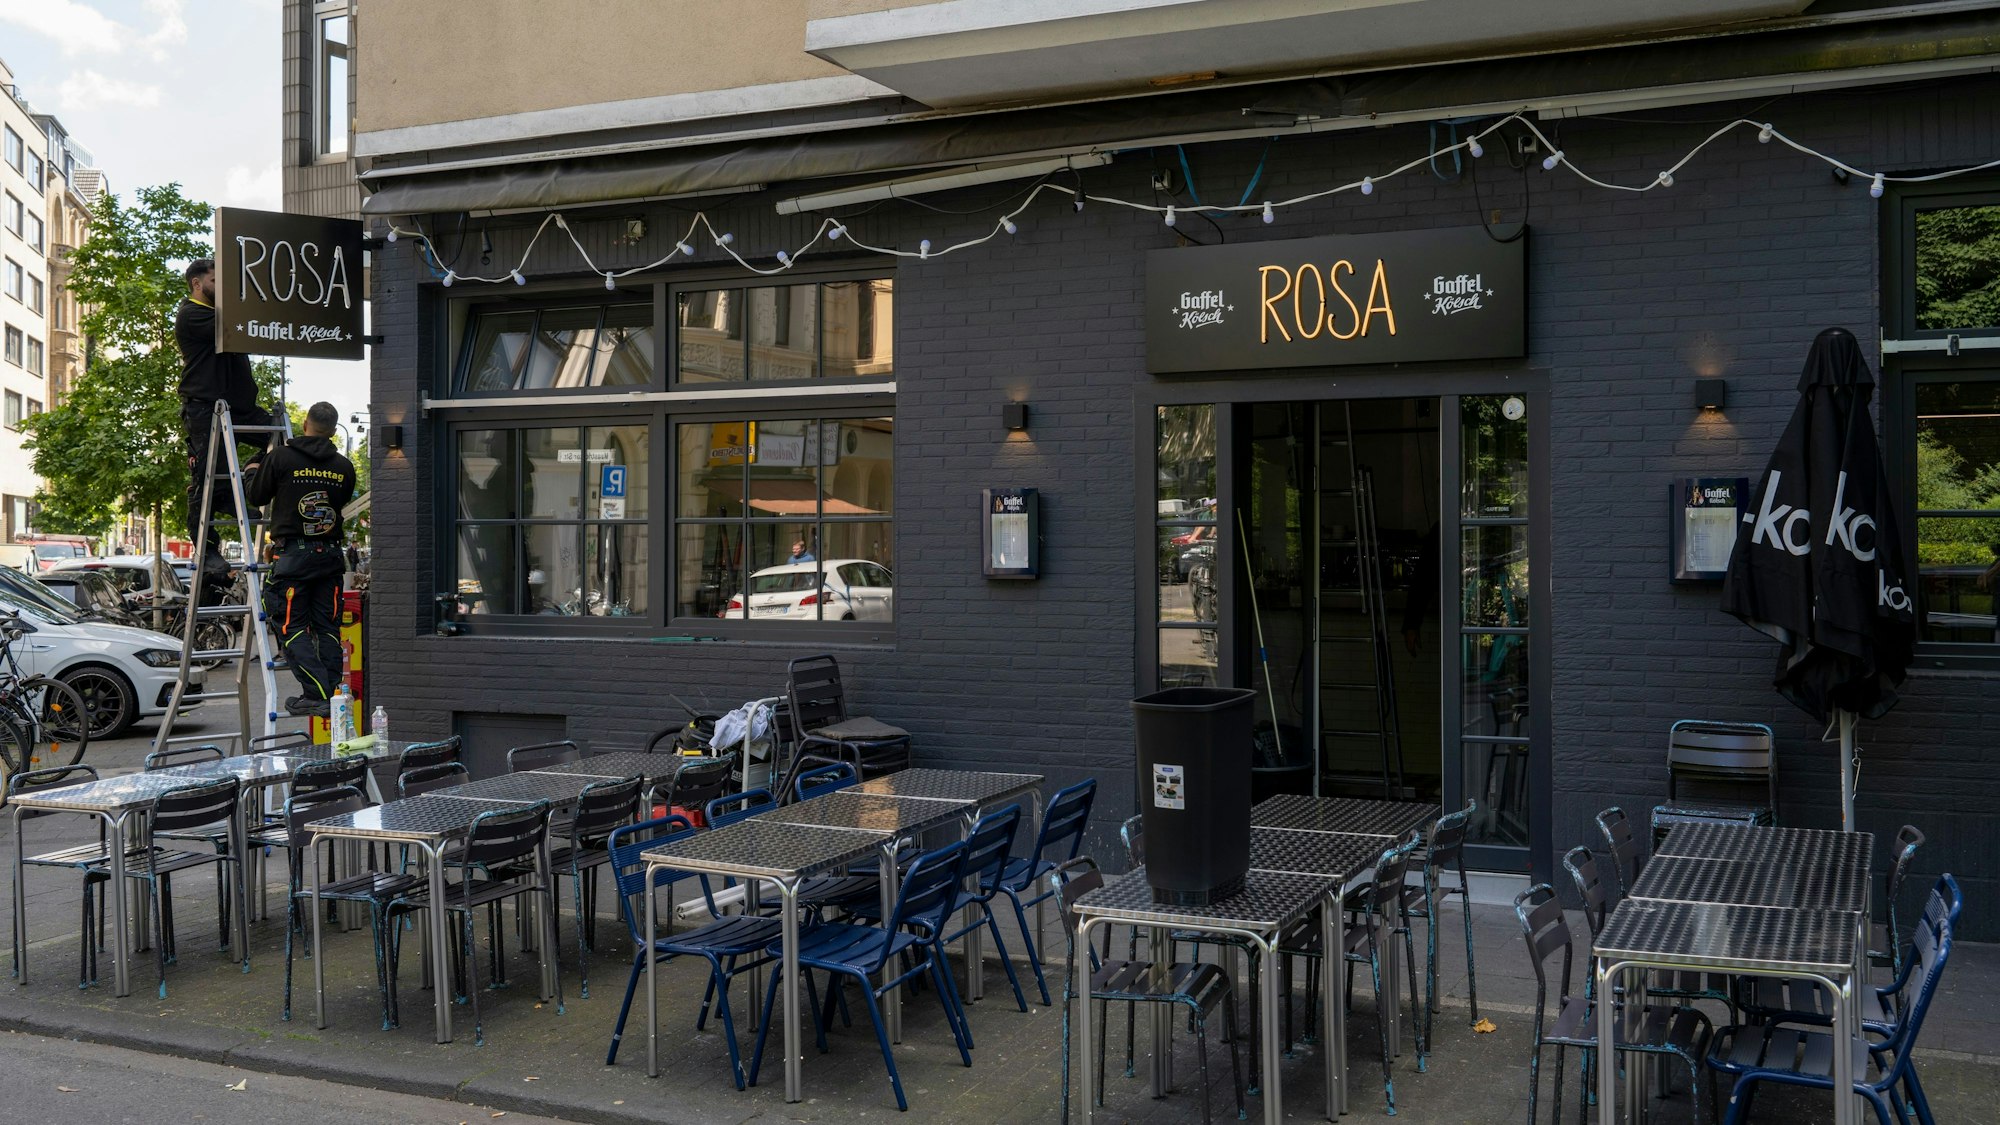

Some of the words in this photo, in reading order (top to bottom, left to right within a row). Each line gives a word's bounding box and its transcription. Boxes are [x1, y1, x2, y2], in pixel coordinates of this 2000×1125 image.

[236, 235, 350, 309] ROSA
[1432, 273, 1483, 295] Gaffel
[1180, 290, 1225, 310] Gaffel
[1258, 259, 1396, 344] ROSA
[1431, 293, 1483, 316] Kölsch
[1179, 308, 1225, 329] Kölsch
[247, 319, 295, 341] Gaffel
[297, 325, 344, 343] Kölsch
[293, 468, 345, 482] schlottag
[1003, 496, 1024, 506] Gaffel
[1704, 487, 1730, 498] Gaffel
